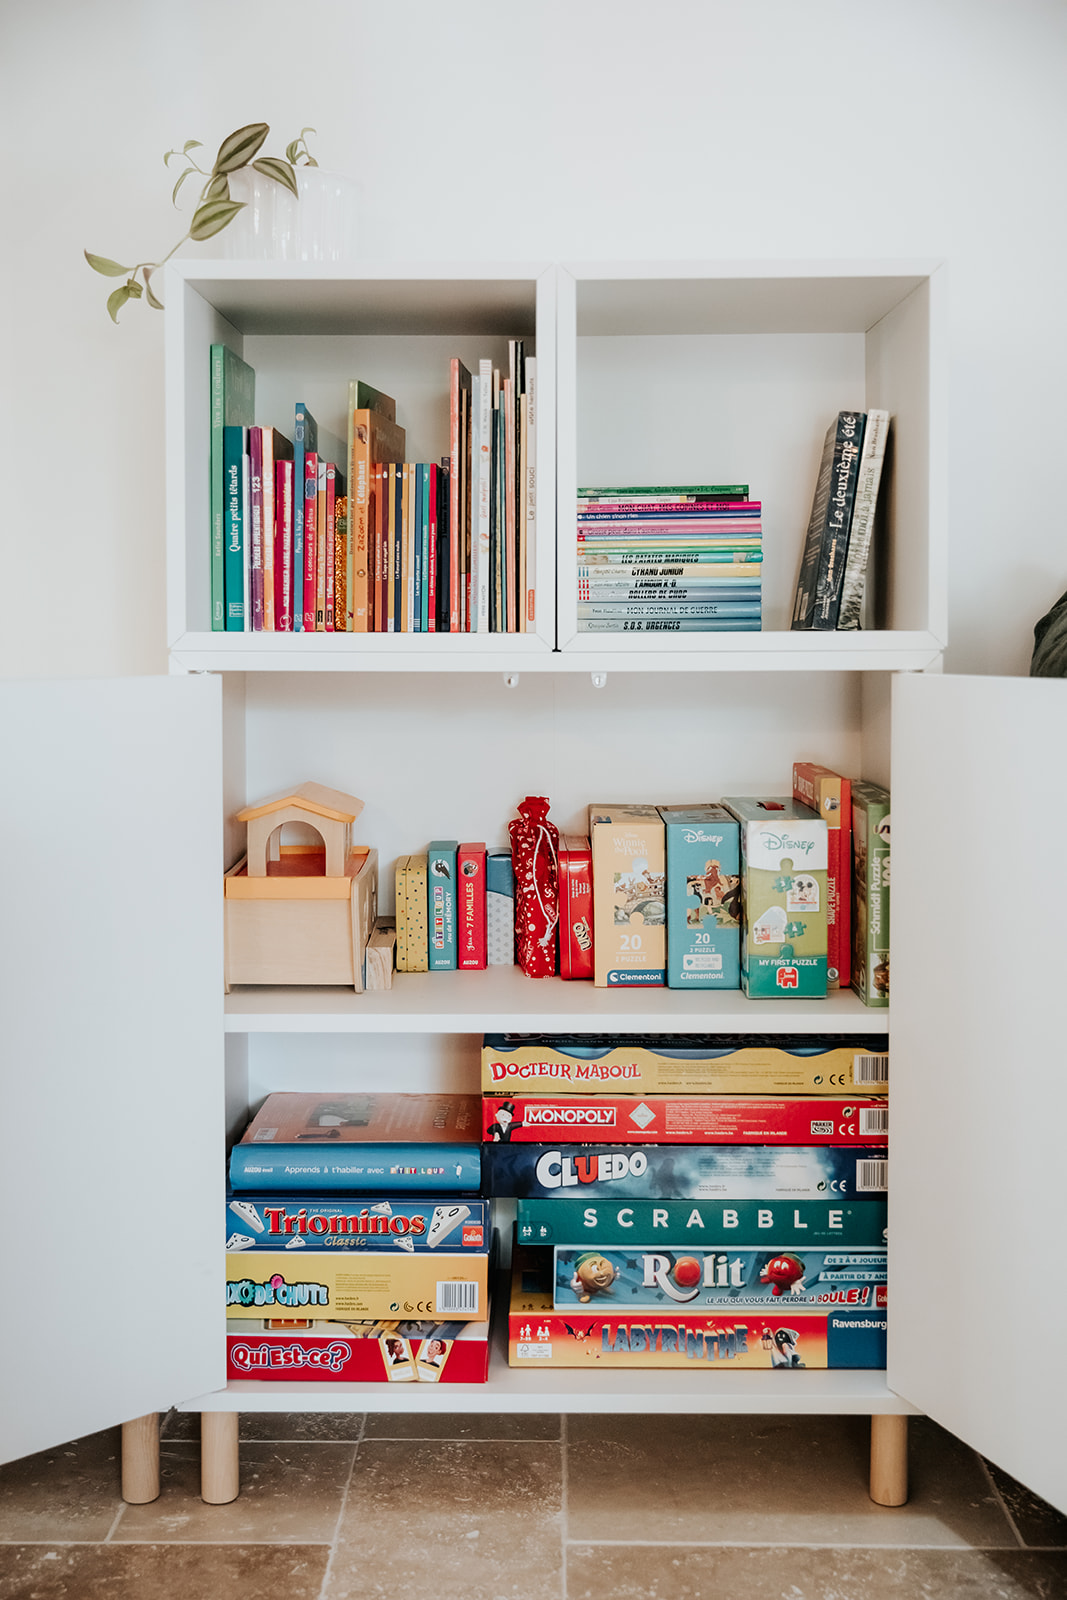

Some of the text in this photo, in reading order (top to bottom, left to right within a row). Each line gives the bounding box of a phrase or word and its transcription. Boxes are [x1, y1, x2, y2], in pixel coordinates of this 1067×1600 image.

[527, 467, 535, 489] souci
[829, 415, 857, 528] Le deuxième été
[253, 476, 261, 493] 123
[264, 472, 272, 495] ABC
[357, 460, 366, 504] L'éléphant
[863, 468, 875, 504] jamais
[228, 465, 241, 552] Quatre petits têtards
[706, 503, 714, 511] ET
[716, 503, 729, 511] MOI
[863, 505, 870, 513] à
[295, 509, 303, 524] plage
[527, 511, 535, 520] Le
[306, 533, 315, 541] de
[326, 530, 334, 541] pipi
[295, 539, 303, 554] Peppa
[326, 543, 334, 555] plus
[306, 542, 315, 571] concours
[326, 556, 334, 567] fait
[622, 554, 700, 563] LES PATATES MAGIQUES
[632, 568, 658, 576] CYRANO
[659, 568, 684, 576] JUNIOR
[628, 590, 688, 599] ROLLERS DE CHOC
[690, 606, 718, 614] GUERRE
[623, 621, 644, 630] S.O.S.
[645, 621, 681, 630] URGENCES
[613, 837, 647, 847] Winnie
[681, 828, 723, 847] Disney
[760, 832, 815, 855] Disney
[624, 846, 649, 856] Pooh
[433, 886, 444, 917] LOUP
[466, 882, 476, 921] FAMILLES
[827, 877, 836, 925] SHAPE PUZZLE
[870, 856, 881, 935] Schmidt Puzzle
[445, 892, 455, 924] MÉMORY
[447, 932, 455, 943] Jeu
[573, 922, 592, 951] UNO
[620, 935, 642, 950] 20
[696, 933, 710, 944] 20
[620, 973, 662, 982] Clementoni
[680, 972, 724, 980] Clementoni
[490, 1061, 575, 1083] DOCTEUR
[575, 1063, 642, 1081] MABOUL
[528, 1110, 613, 1123] MONOPOLY
[284, 1165, 320, 1175] Apprends
[332, 1166, 364, 1174] t'habiller
[536, 1150, 648, 1189] CLUEDO
[264, 1207, 425, 1236] Triominos
[583, 1208, 843, 1229] SCRABBLE
[324, 1235, 367, 1246] Classic
[463, 1233, 483, 1242] Goliath
[845, 1256, 851, 1264] À
[642, 1253, 746, 1303] Rolit
[823, 1272, 829, 1280] À
[276, 1284, 328, 1306] CHUTE
[816, 1286, 871, 1306] BOULE!
[601, 1323, 749, 1362] LABYRINTHE
[233, 1342, 350, 1373] Qui Est-ce?
